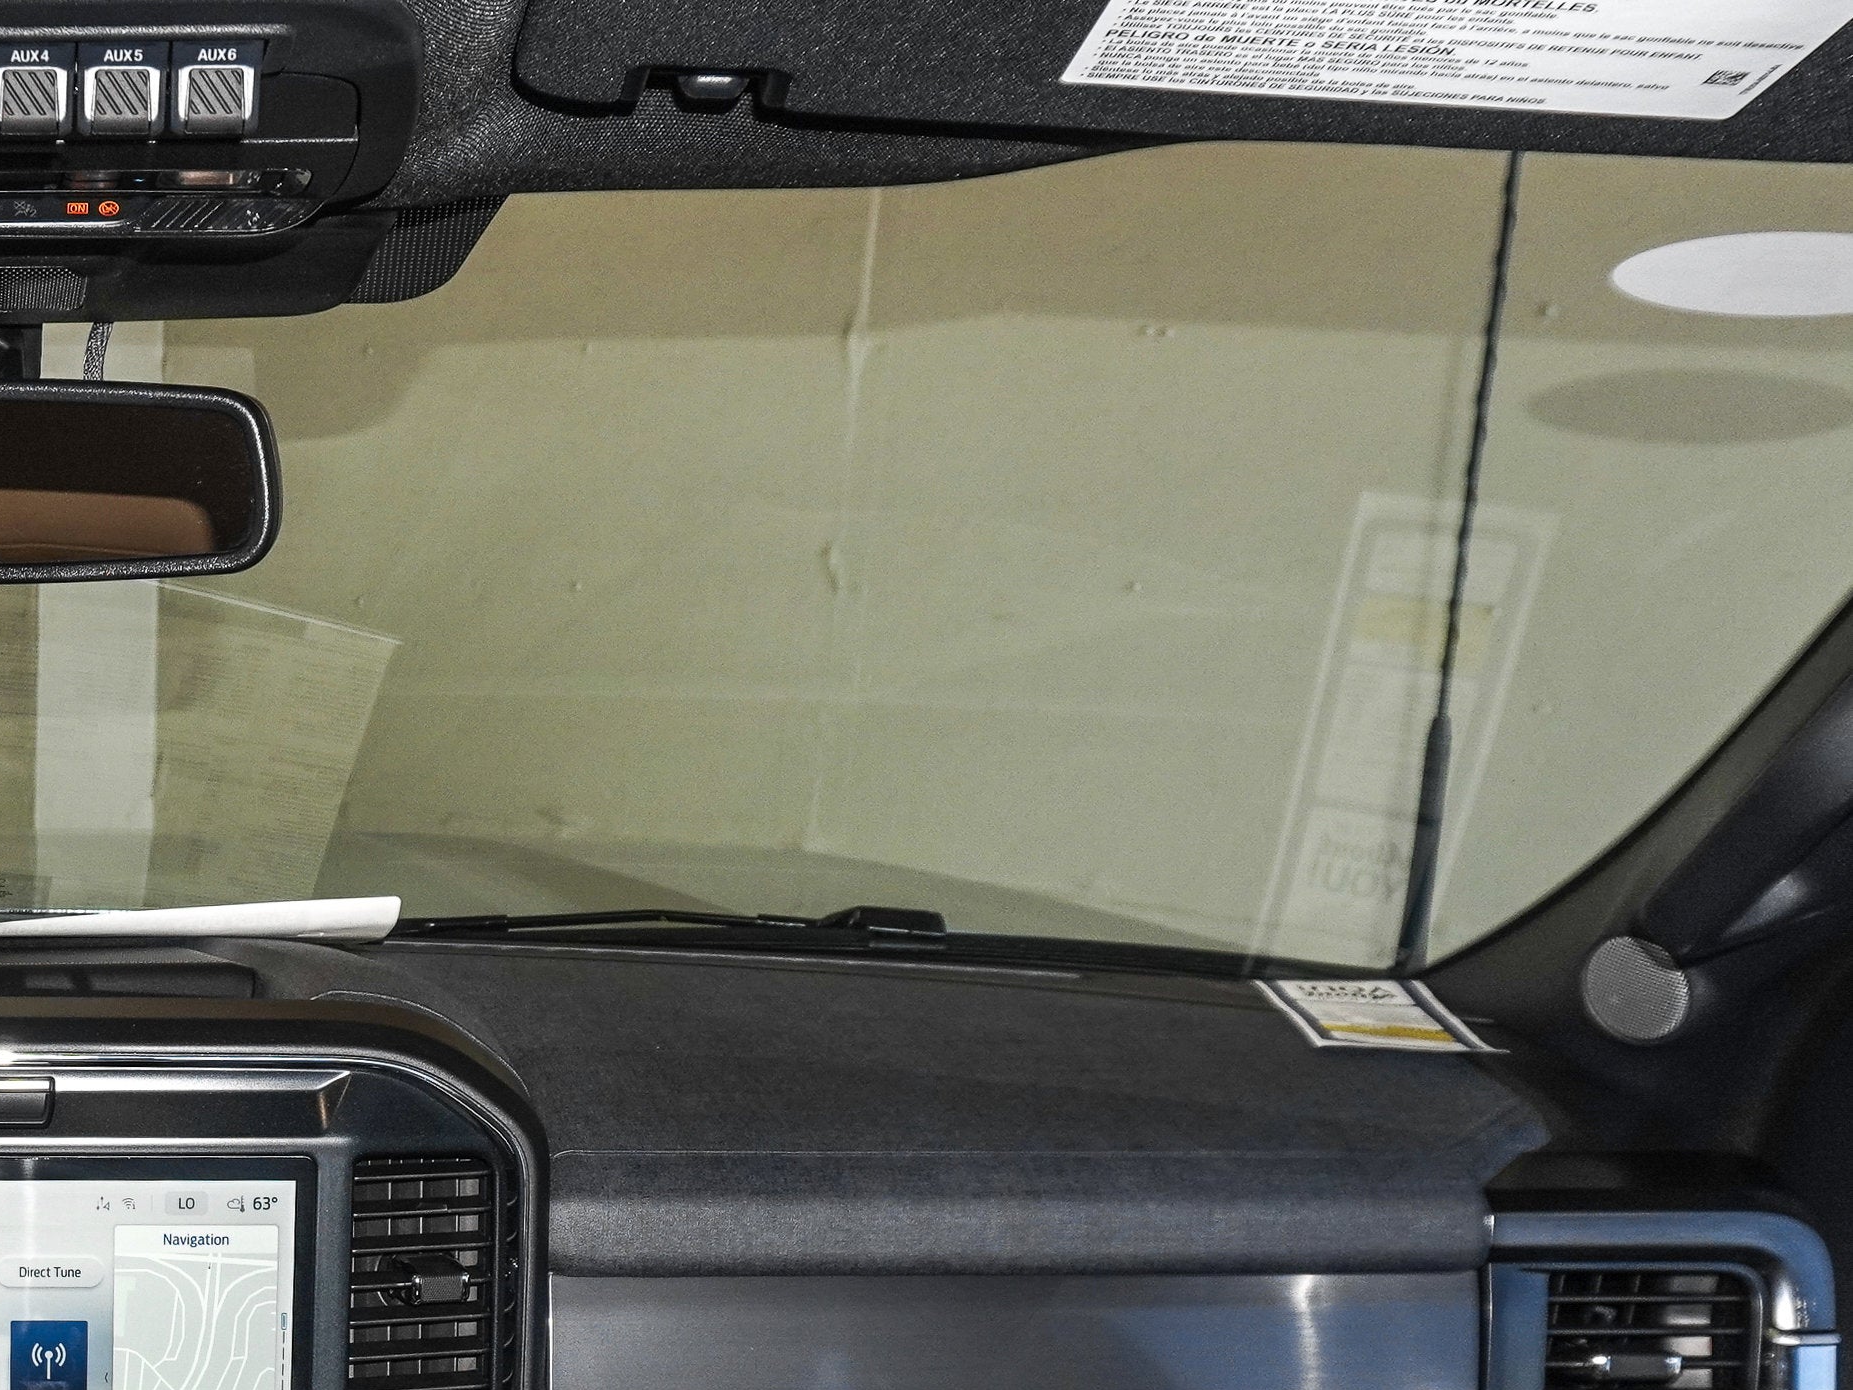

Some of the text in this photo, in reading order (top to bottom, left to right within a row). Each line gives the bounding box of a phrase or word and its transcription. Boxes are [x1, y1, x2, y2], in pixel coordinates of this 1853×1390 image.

[1105, 29, 1189, 41] PELIGRO
[1194, 33, 1216, 42] de
[1221, 35, 1301, 48] MUERTE
[1321, 40, 1378, 51] SERIA
[69, 204, 87, 214] ON
[178, 1198, 195, 1210] LO
[252, 1196, 278, 1211] 63°
[163, 1233, 230, 1248] Navigation
[19, 1266, 82, 1278] Direct Tune
